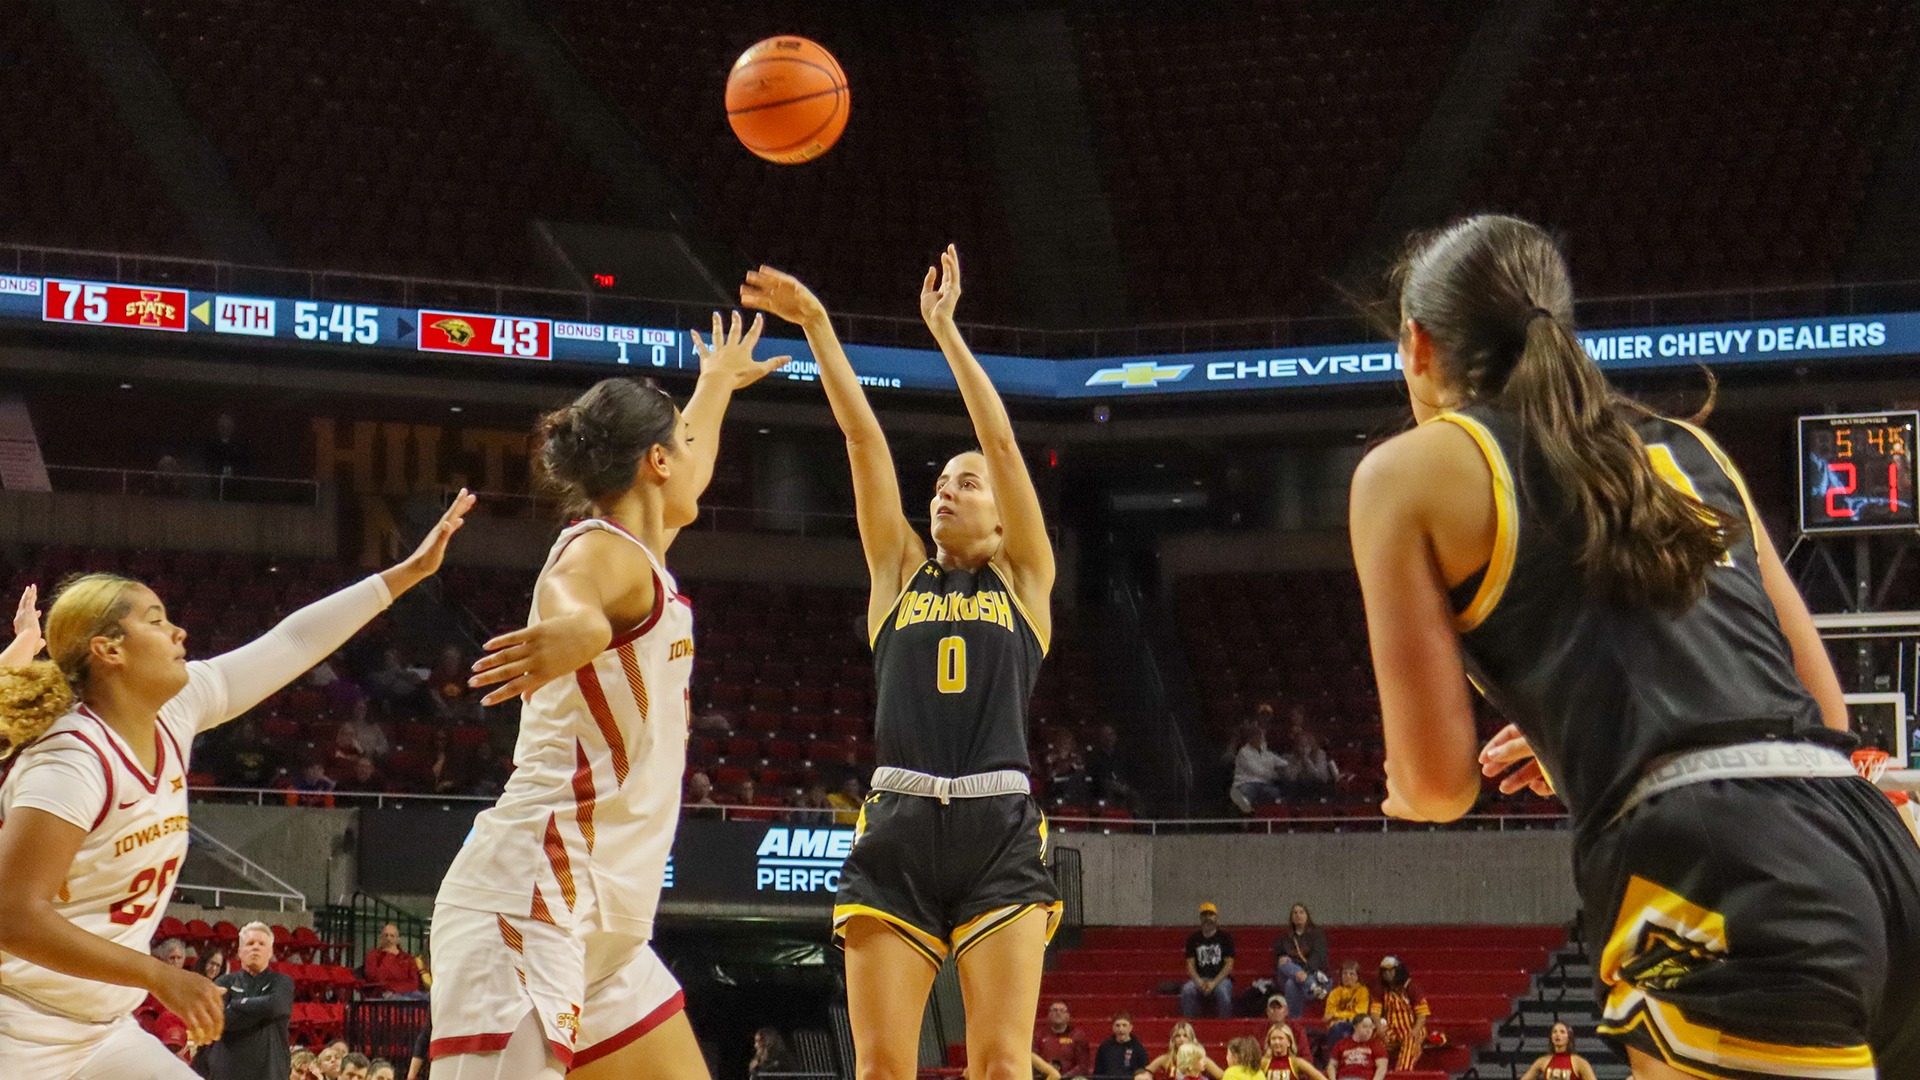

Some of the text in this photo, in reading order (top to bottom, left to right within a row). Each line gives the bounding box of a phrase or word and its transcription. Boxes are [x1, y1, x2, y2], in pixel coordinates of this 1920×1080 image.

[58, 283, 108, 322] 75
[125, 300, 175, 320] STATE
[222, 303, 269, 329] 4TH
[294, 302, 378, 344] 5:45
[491, 319, 539, 356] 43
[557, 323, 670, 344] BONUS FLS TOL
[1573, 322, 1887, 361] MIER CHEVY DEALERS
[617, 342, 630, 364] 1
[651, 345, 666, 367] 0
[1826, 462, 1898, 517] 21
[895, 590, 1013, 632] OSHKOSH
[937, 636, 966, 693] 0
[113, 824, 162, 858] IOWA
